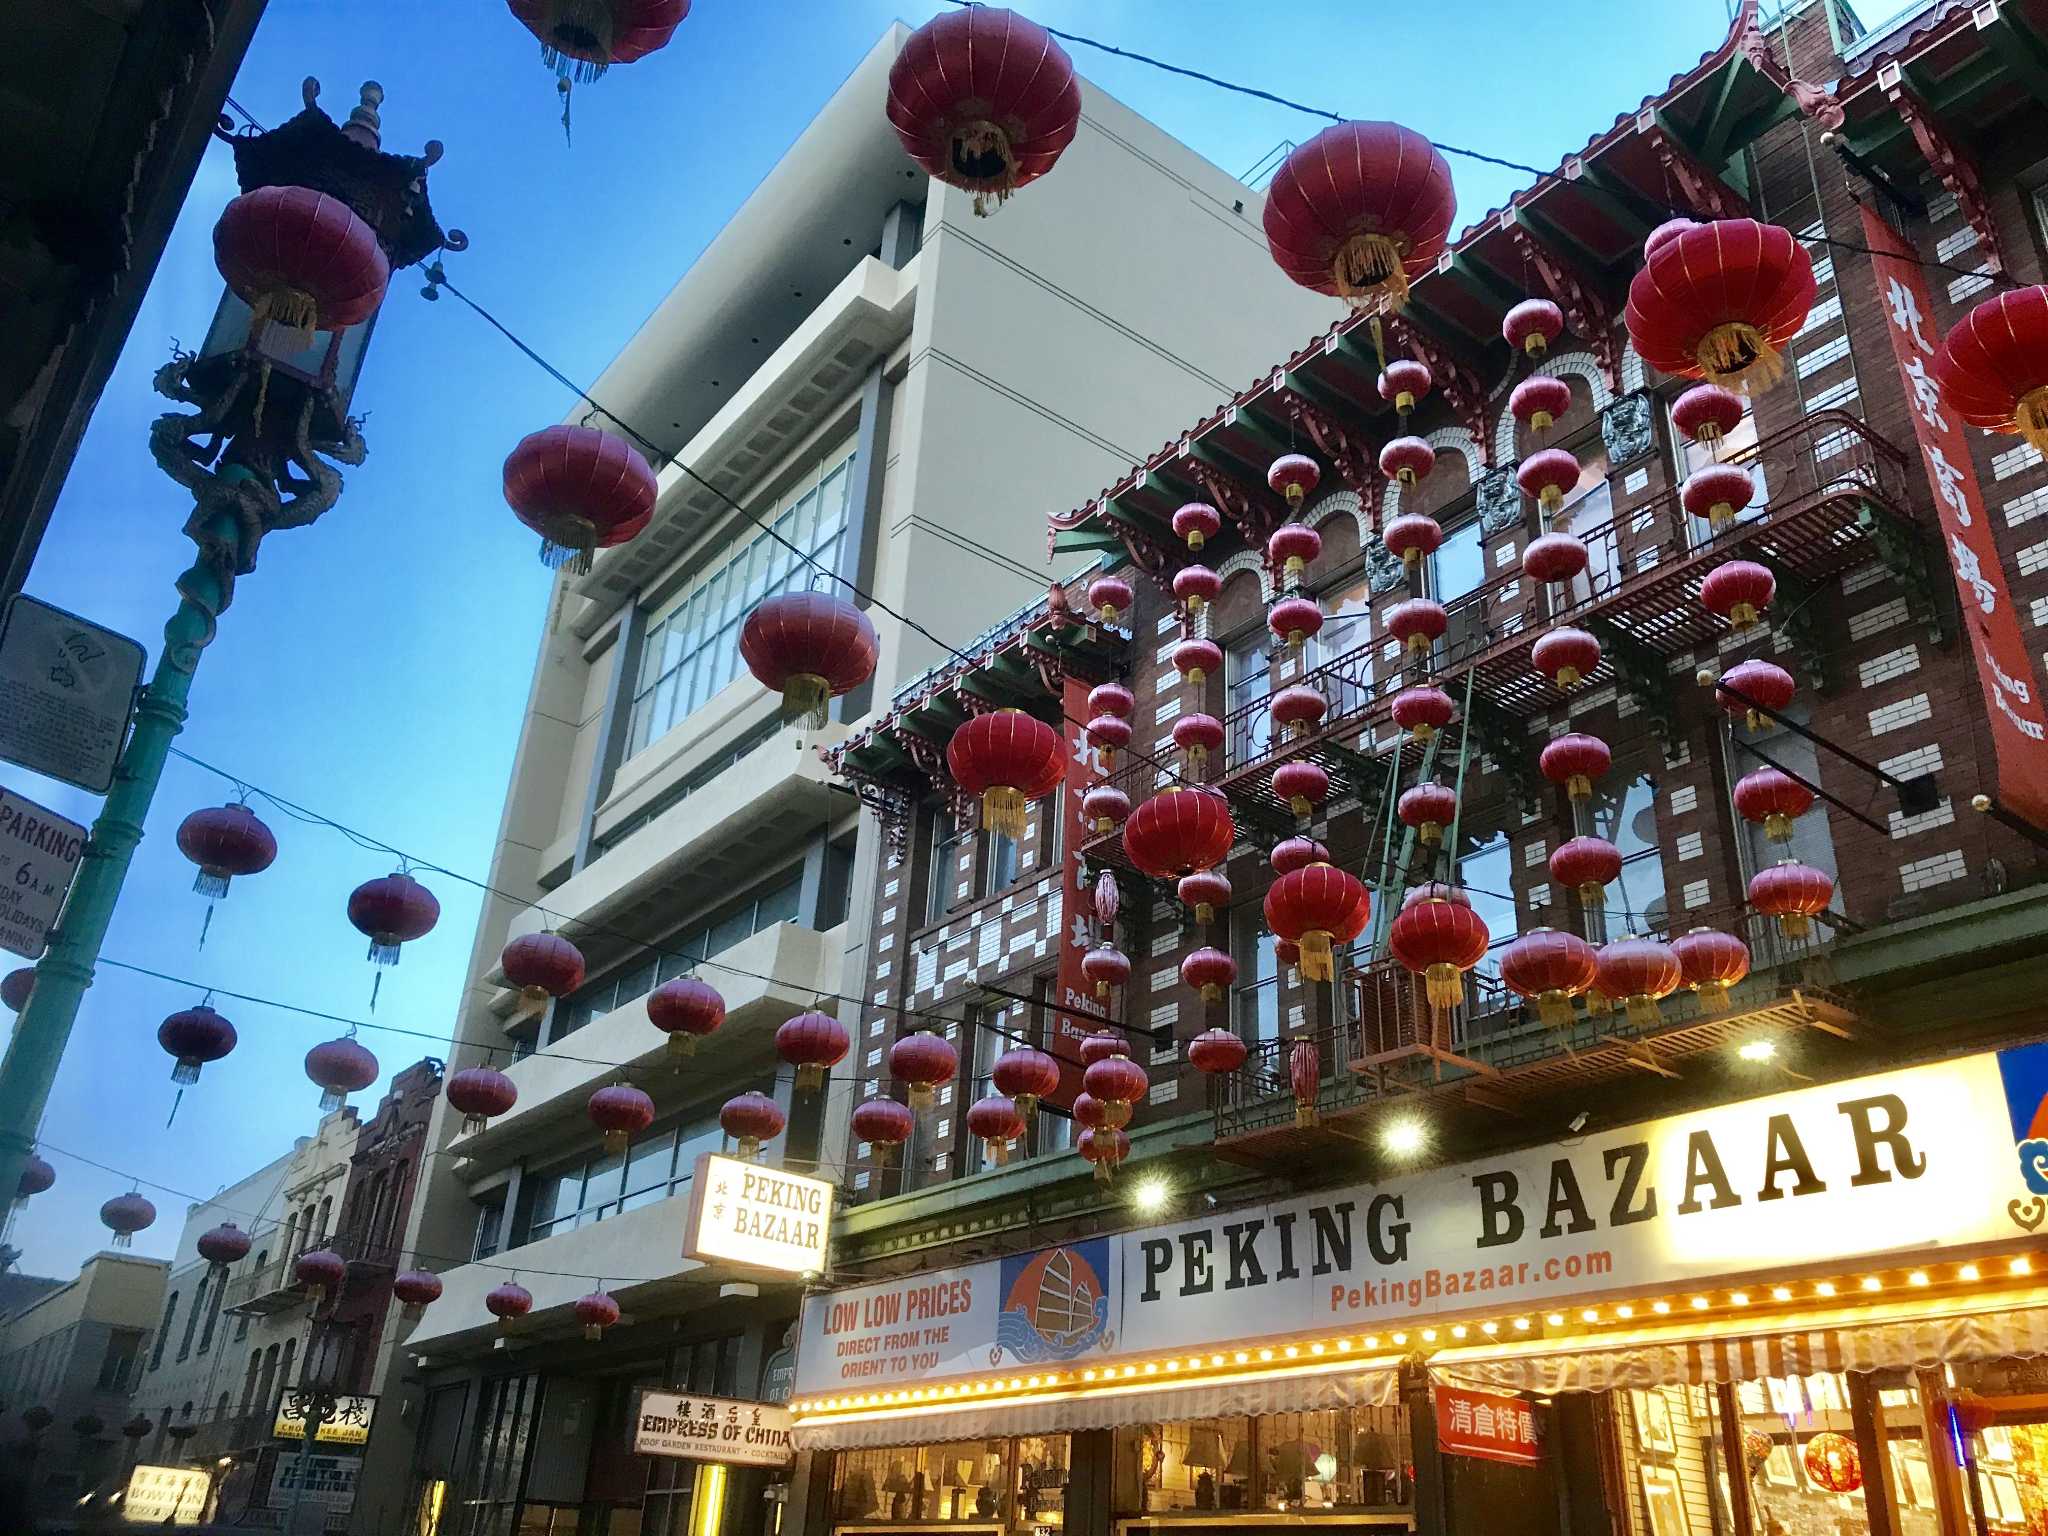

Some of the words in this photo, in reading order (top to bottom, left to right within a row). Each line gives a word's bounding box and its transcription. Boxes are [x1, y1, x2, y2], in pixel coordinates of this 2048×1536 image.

[15, 861, 32, 886] 6
[741, 1172, 821, 1215] PEKING
[1140, 1193, 1412, 1303] PEKING
[1472, 1093, 1926, 1249] BAZAAR
[733, 1206, 820, 1250] BAZAAR
[1331, 1249, 1613, 1312] PekingBazaar.com
[823, 1302, 858, 1336] LOW
[863, 1292, 903, 1328] LOW
[906, 1278, 972, 1322] PRICES
[837, 1335, 881, 1357] DIRECT
[884, 1331, 920, 1352] FROM
[923, 1326, 950, 1345] THE
[841, 1358, 887, 1379] ORIENT
[889, 1356, 909, 1373] TO
[910, 1352, 940, 1370] YOU
[642, 1414, 719, 1440] EMPRESS
[722, 1424, 742, 1441] OF
[745, 1426, 791, 1448] CHINA
[1448, 1396, 1539, 1446] 清倉特價
[640, 1437, 659, 1447] ROOF
[662, 1439, 691, 1450] GARDEN
[694, 1443, 741, 1455] RESTAURANT
[1034, 1527, 1051, 1536] 832
